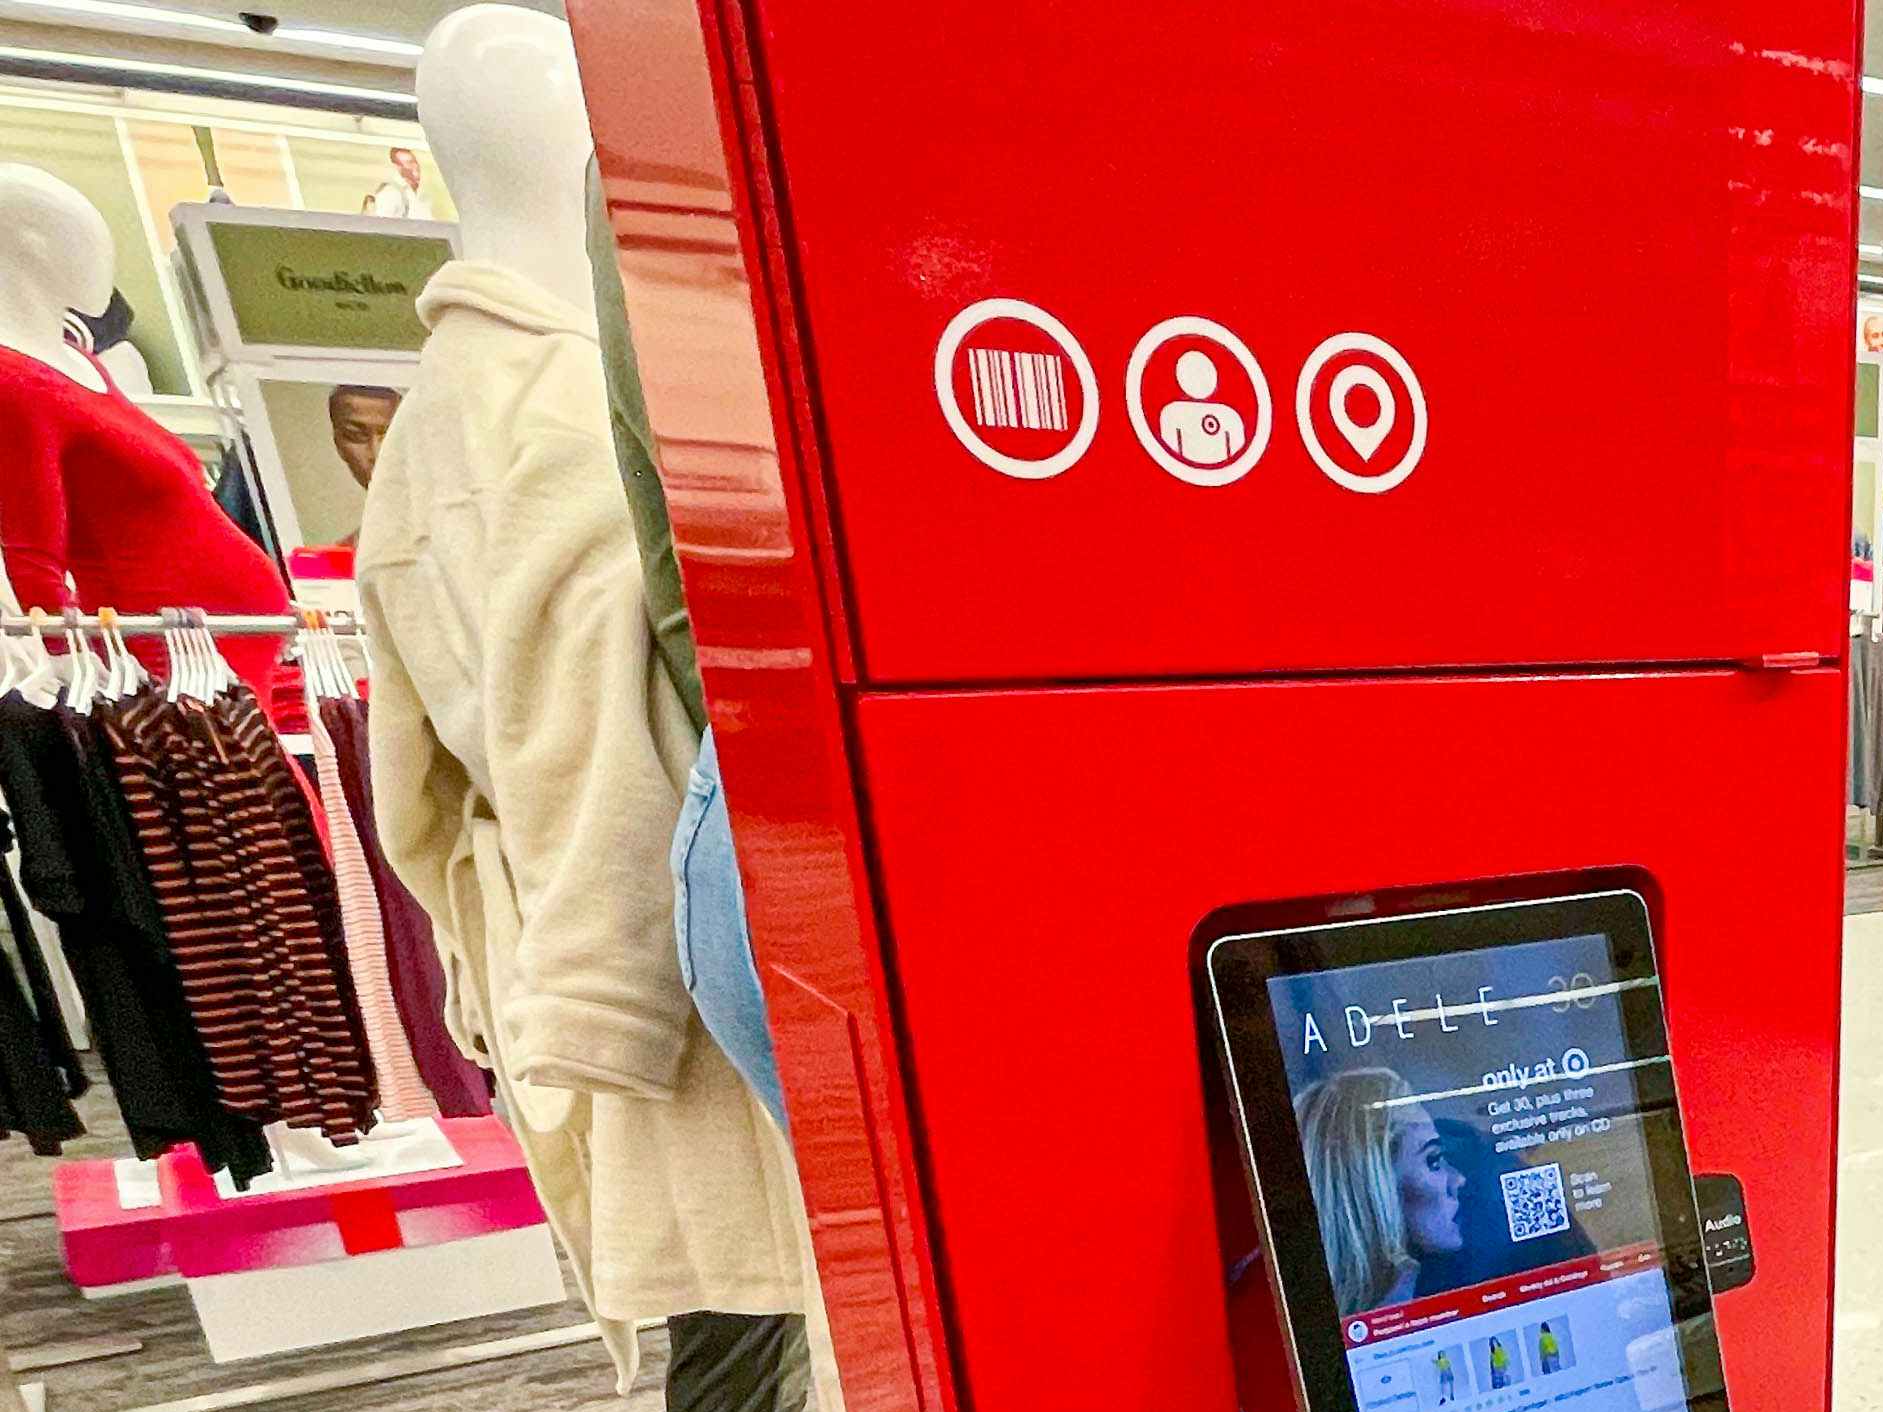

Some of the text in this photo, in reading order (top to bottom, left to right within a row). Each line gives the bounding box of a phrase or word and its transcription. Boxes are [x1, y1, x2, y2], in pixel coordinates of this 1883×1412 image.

[1303, 986, 1499, 1055] ADELE
[1482, 1058, 1556, 1090] only at
[1705, 1214, 1742, 1233] Audio
